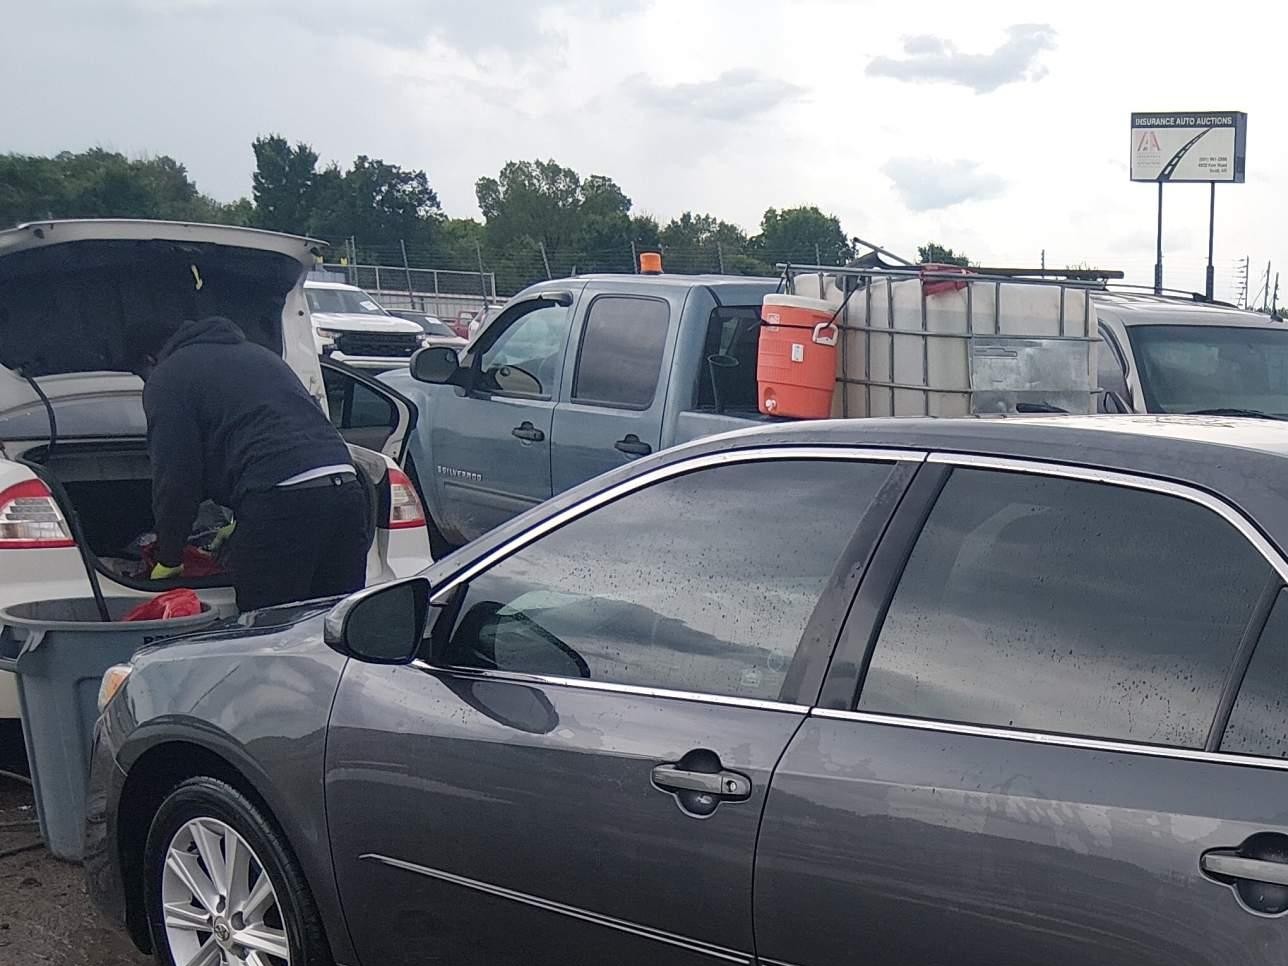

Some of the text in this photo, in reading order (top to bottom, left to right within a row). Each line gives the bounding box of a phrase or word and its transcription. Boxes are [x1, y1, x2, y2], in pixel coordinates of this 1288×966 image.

[1135, 116, 1233, 126] INSURANCE AUTO AUCTIONS
